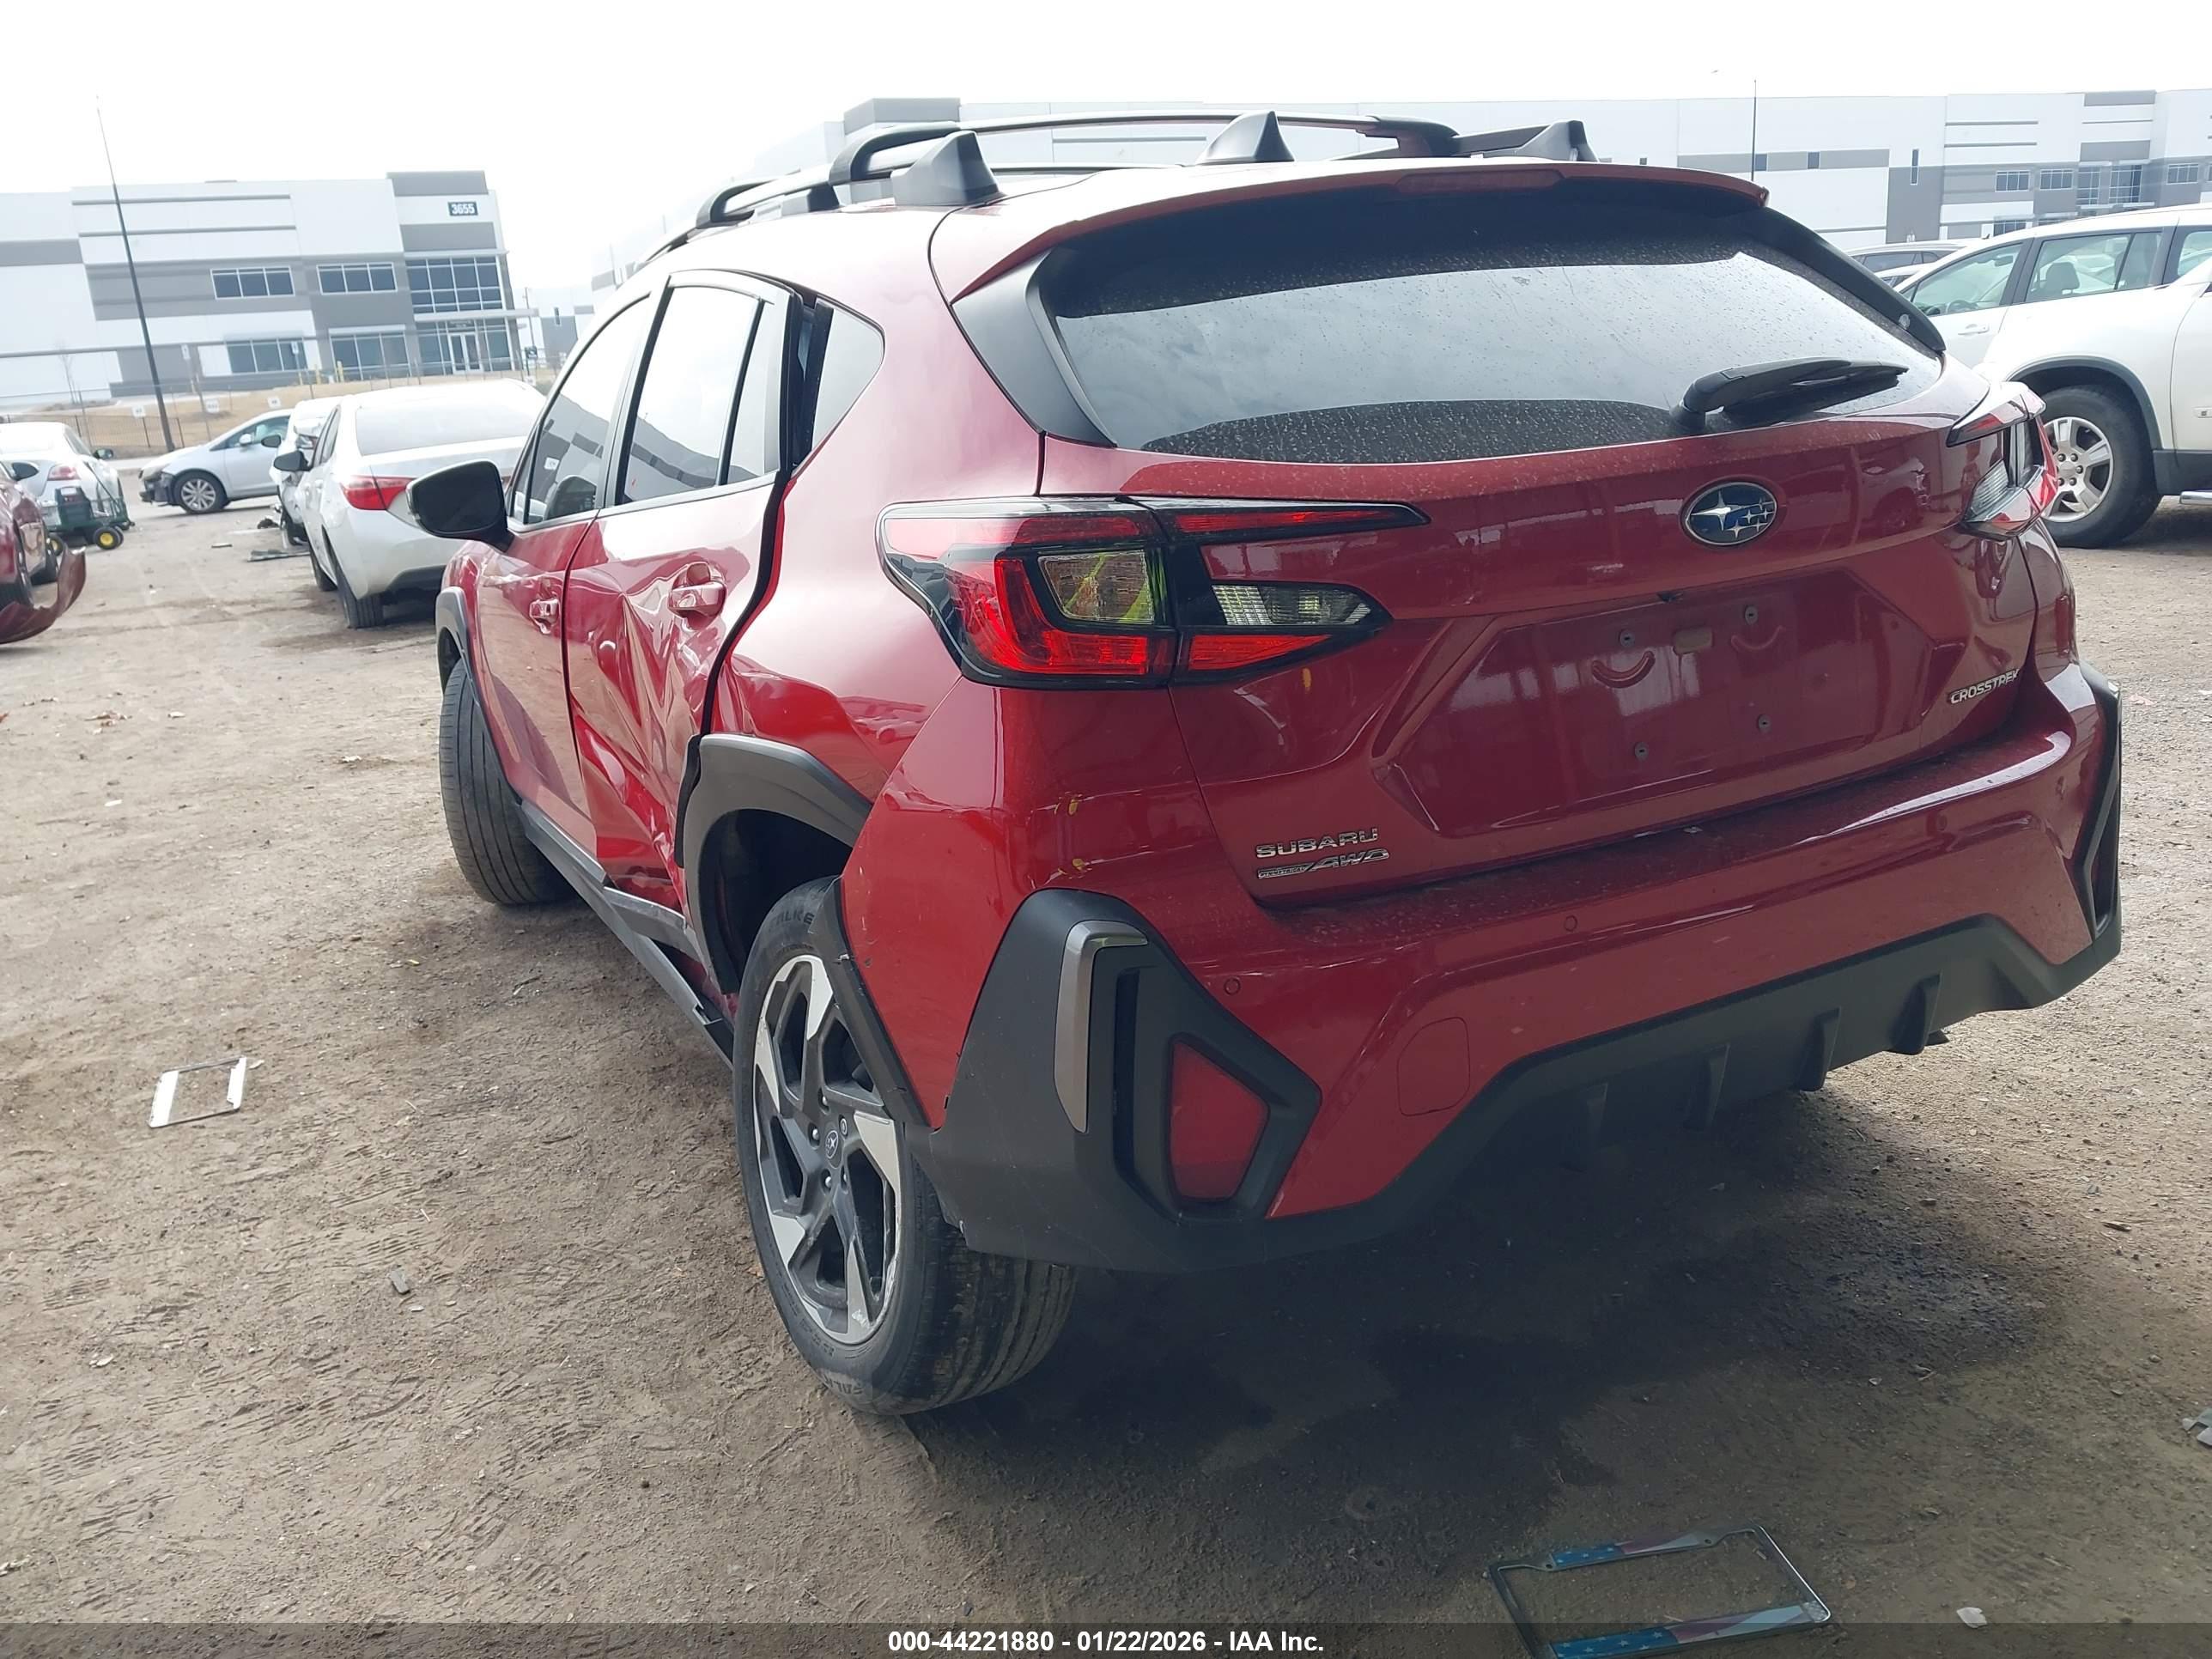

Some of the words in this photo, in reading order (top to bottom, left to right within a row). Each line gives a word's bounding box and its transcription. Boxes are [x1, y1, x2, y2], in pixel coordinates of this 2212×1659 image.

[451, 203, 476, 215] 3655
[1949, 668, 2021, 704] CROSSTREK
[1255, 828, 1379, 858] SUBARU
[1309, 848, 1390, 871] AWD
